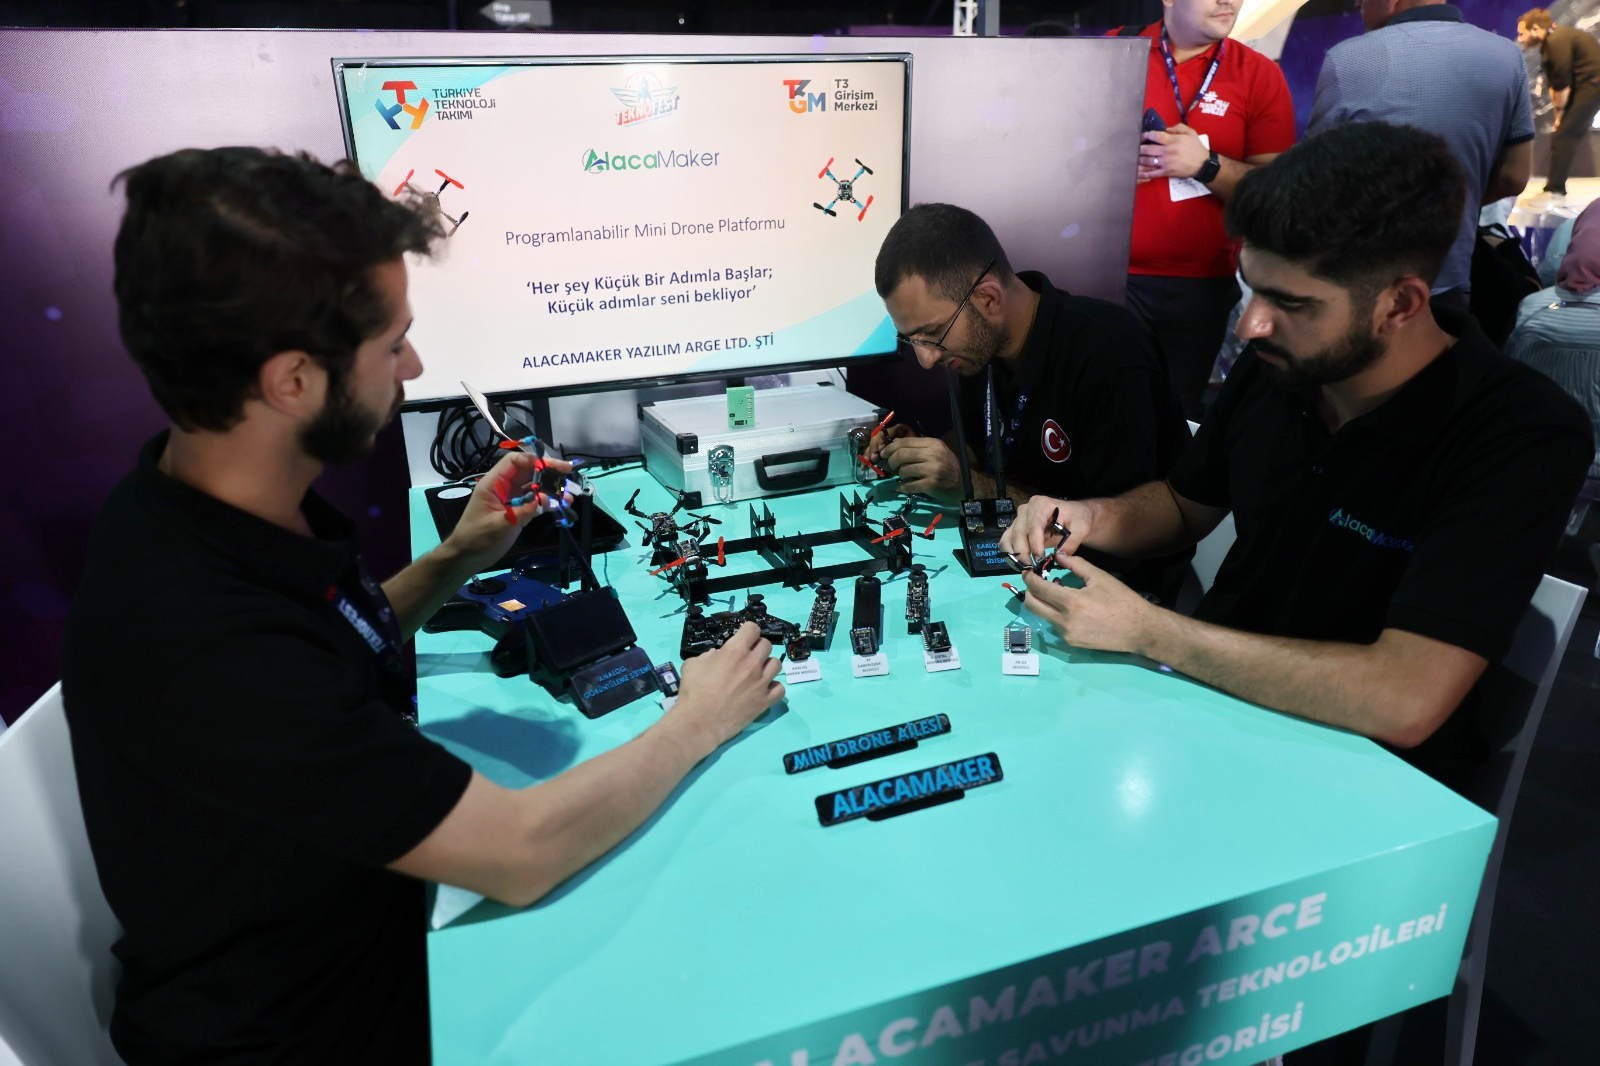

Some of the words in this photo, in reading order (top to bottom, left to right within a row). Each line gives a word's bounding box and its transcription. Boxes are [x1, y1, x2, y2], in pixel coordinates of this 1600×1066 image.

[432, 87, 481, 99] TÜRKİYE
[834, 79, 849, 89] T3
[834, 90, 874, 101] Girişim
[436, 110, 473, 121] TAKIMI
[834, 100, 878, 112] Merkezi
[582, 148, 720, 174] AlacaMaker
[505, 228, 629, 248] Programlanabilir
[635, 222, 667, 238] Mini
[671, 221, 715, 236] Drone
[719, 216, 786, 233] Platformu
[565, 281, 591, 296] şey
[594, 273, 641, 292] Küçük
[644, 272, 666, 287] Bir
[669, 268, 721, 285] Adımla
[725, 265, 774, 282] Başlar;
[547, 298, 595, 316] Küçük
[598, 293, 657, 311] adımlar
[660, 290, 691, 306] seni
[522, 347, 622, 369] ALACAMAKER
[626, 342, 682, 359] YAZILIM
[685, 338, 722, 355] ARGE
[725, 337, 752, 350] LTD.
[755, 331, 775, 348] ŞTİ
[793, 744, 833, 771] MİNİ
[836, 730, 894, 758] DRONE
[897, 714, 943, 742] AİLESİ
[832, 756, 996, 819] ALACAMAKER
[1198, 902, 1448, 1009] TEKNOLOJİLERİ
